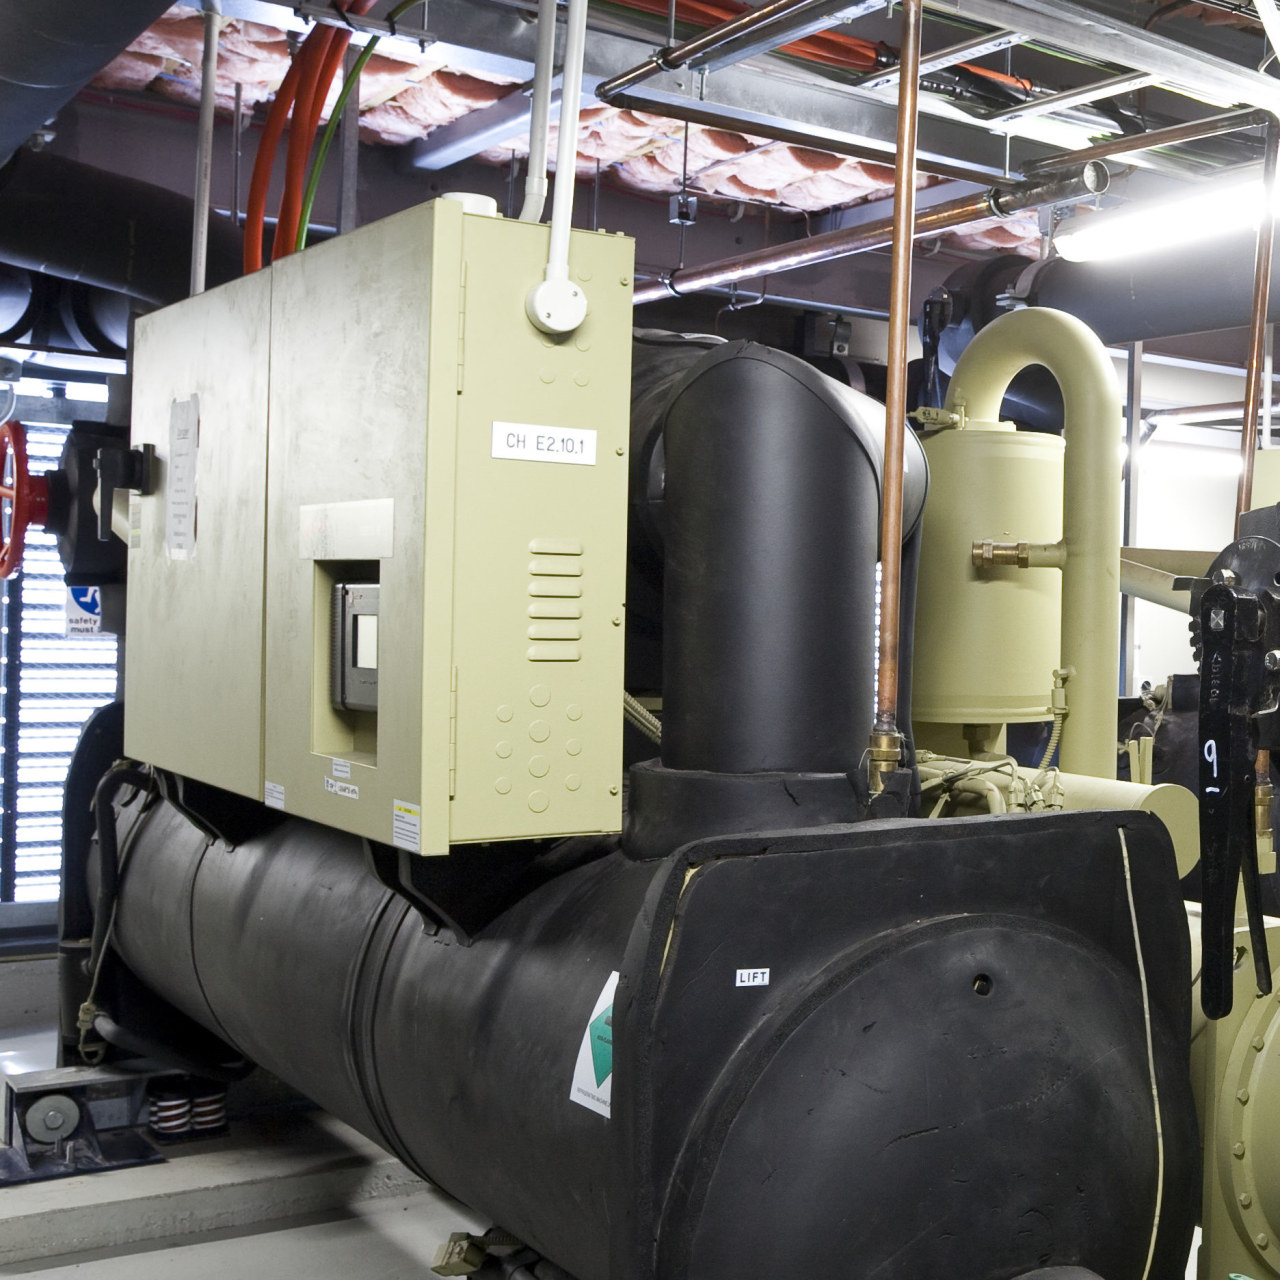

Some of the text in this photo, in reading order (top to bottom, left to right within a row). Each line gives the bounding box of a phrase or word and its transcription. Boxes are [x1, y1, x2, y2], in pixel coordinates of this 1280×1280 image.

[506, 433, 584, 454] CH E2.10.1
[69, 617, 98, 625] safety
[740, 971, 767, 983] LIFT
